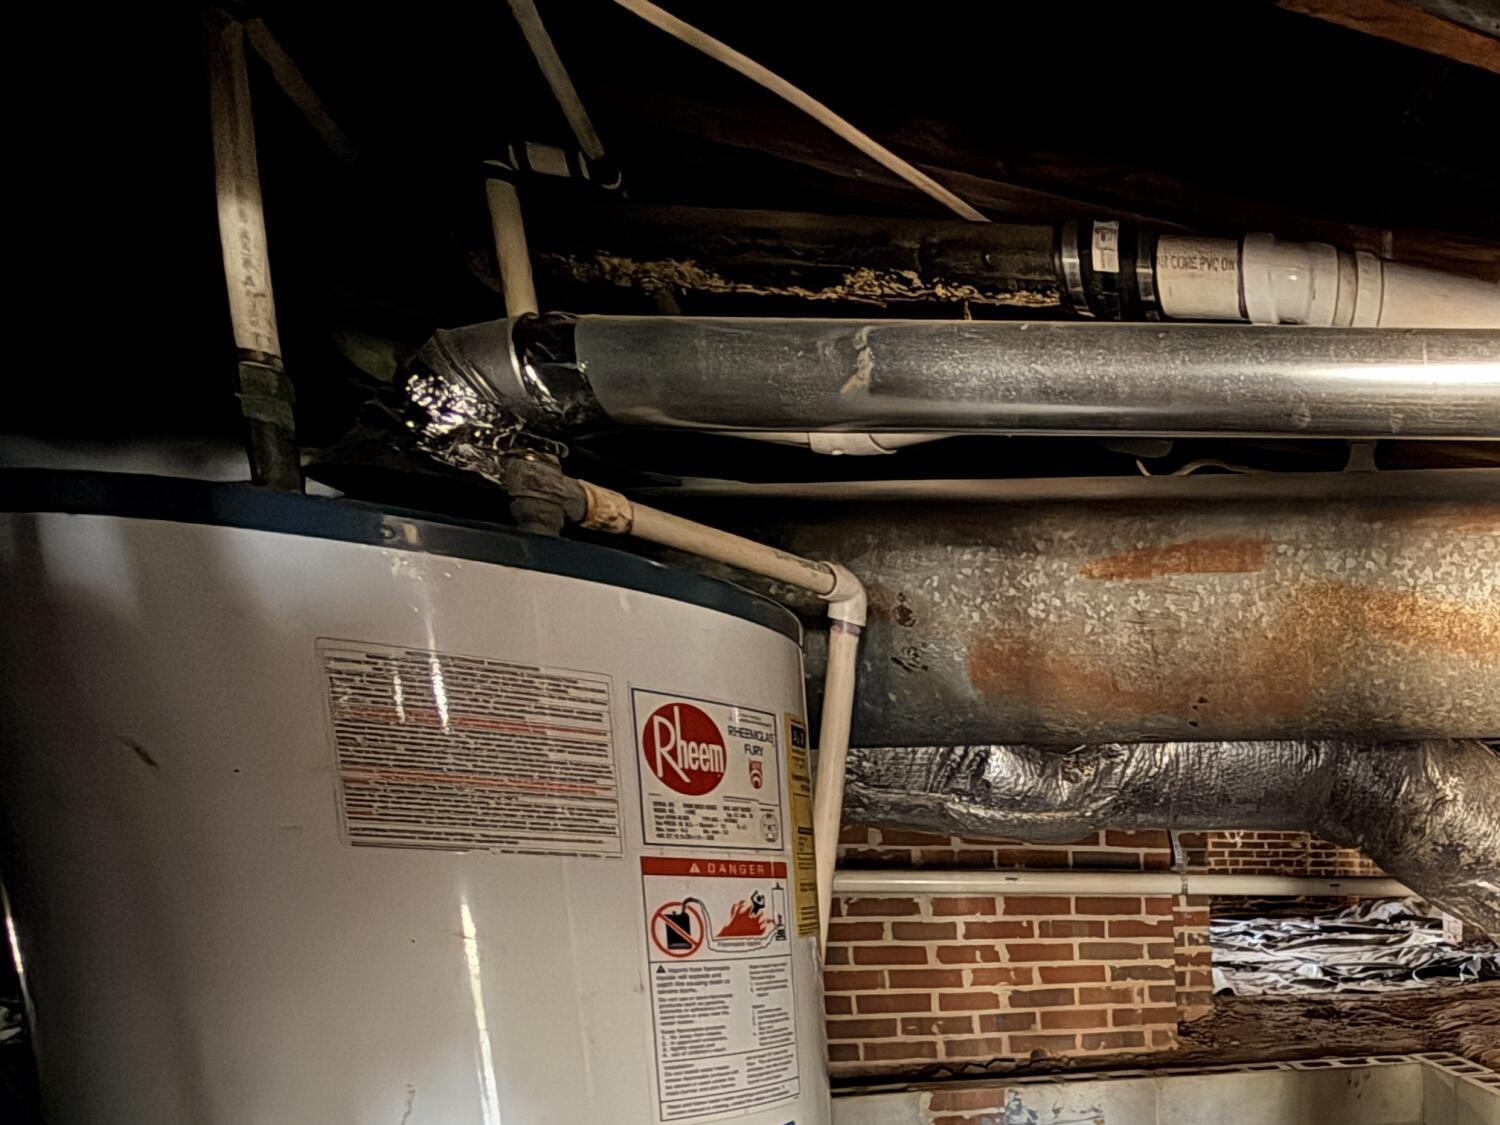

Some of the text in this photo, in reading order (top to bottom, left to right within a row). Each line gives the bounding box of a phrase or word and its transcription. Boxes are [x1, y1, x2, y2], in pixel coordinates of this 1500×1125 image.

[1171, 255, 1198, 270] CORE
[1199, 255, 1219, 271] PVC
[653, 705, 724, 783] Rheem
[744, 744, 763, 756] FURY
[708, 863, 766, 875] DANGER
